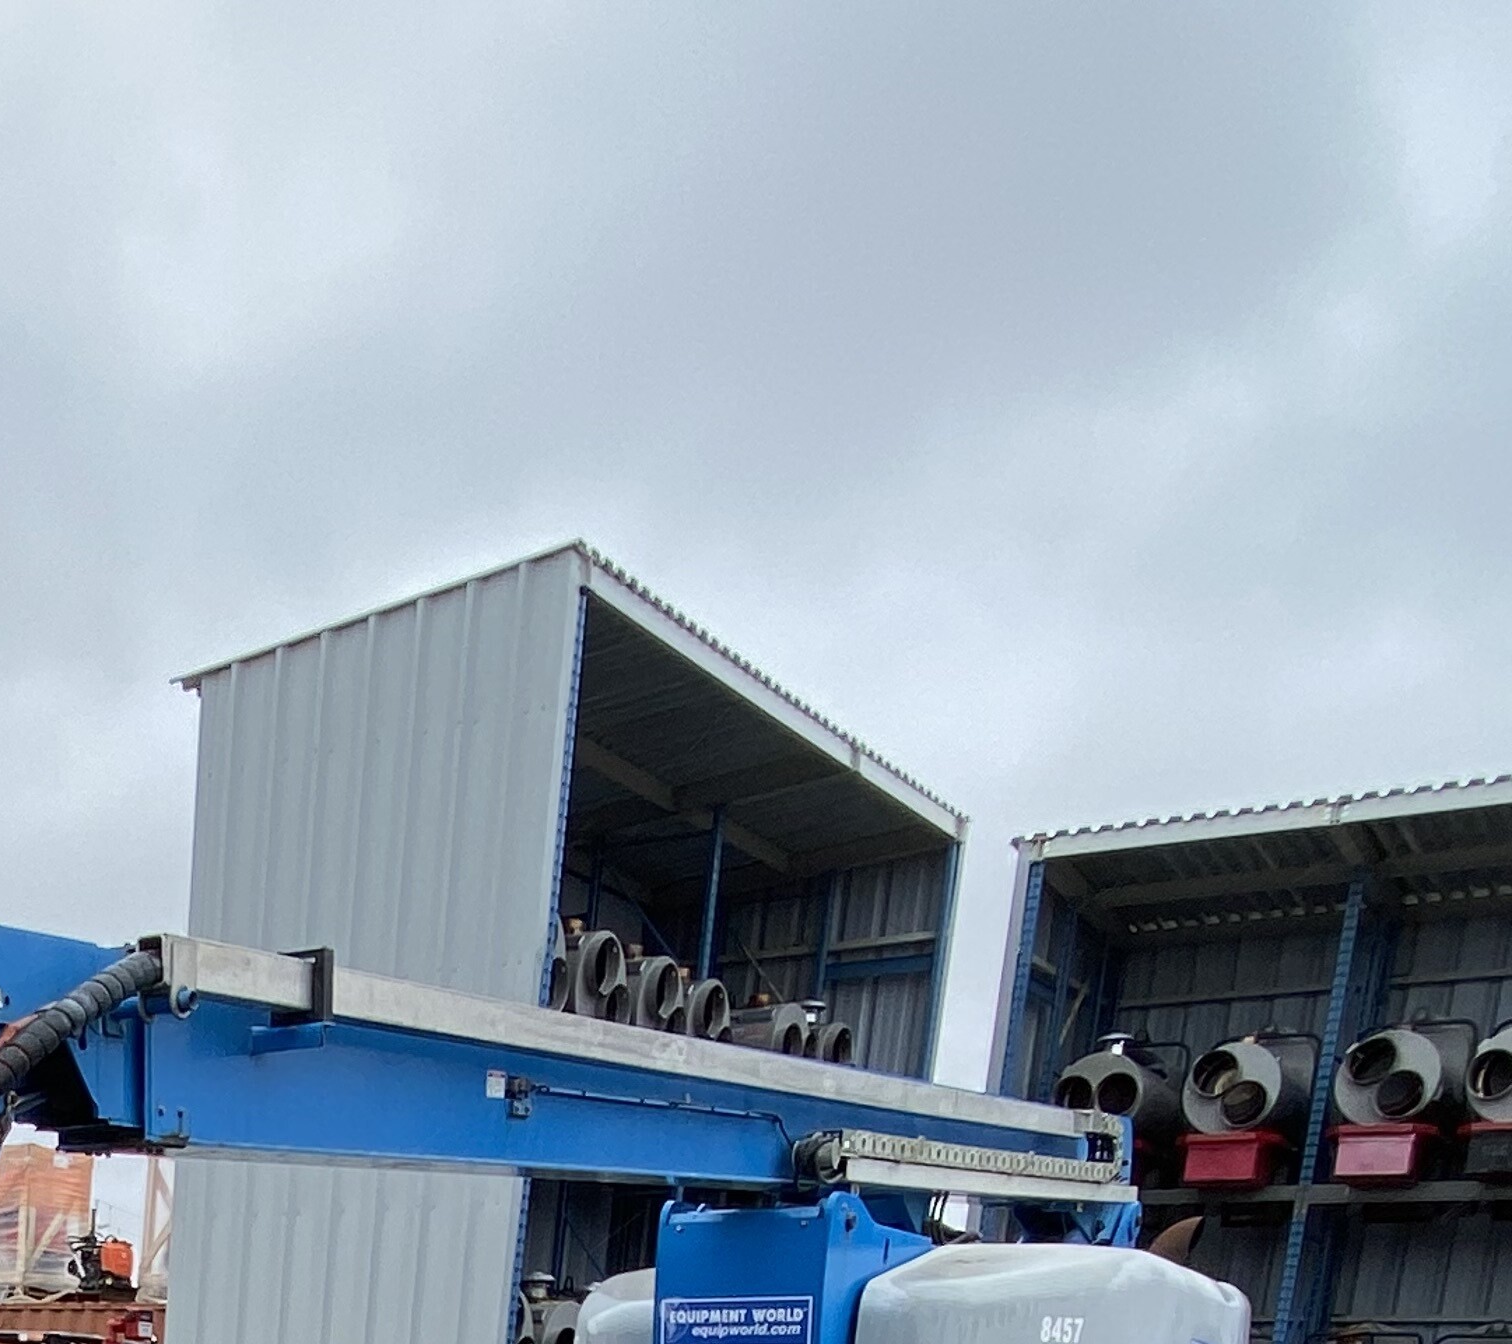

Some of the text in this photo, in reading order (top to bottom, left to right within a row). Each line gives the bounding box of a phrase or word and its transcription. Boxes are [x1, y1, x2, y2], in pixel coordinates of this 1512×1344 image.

[669, 1307, 804, 1324] EQUIPMENT WORLD
[691, 1323, 801, 1339] equipworld.com
[1040, 1316, 1085, 1344] 8457
